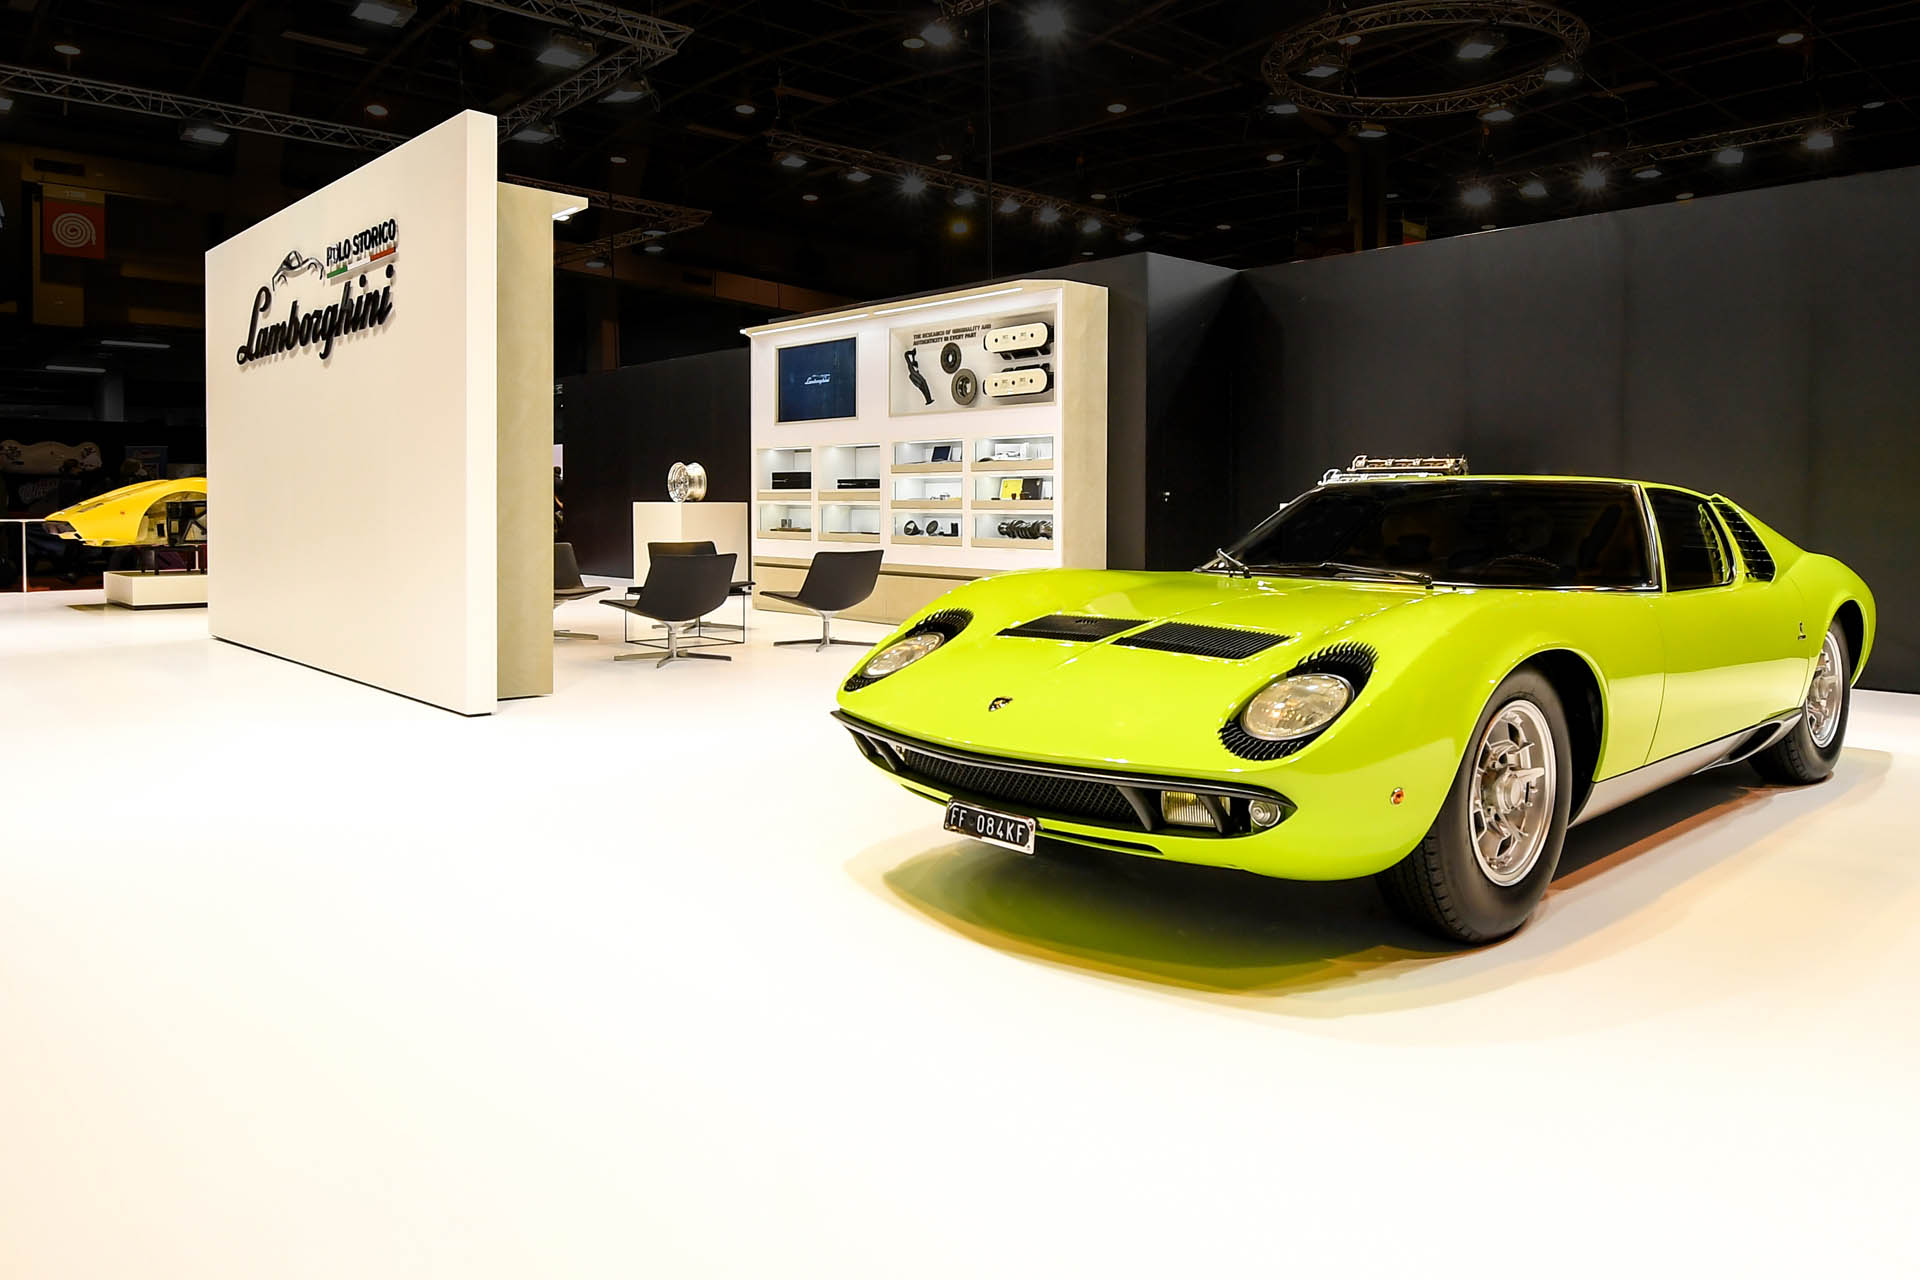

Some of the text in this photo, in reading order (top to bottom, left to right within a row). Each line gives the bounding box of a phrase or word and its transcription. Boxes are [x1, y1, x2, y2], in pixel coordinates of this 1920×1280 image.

[327, 219, 396, 266] POLO STORICO
[236, 264, 394, 365] Lamborghini
[950, 807, 1026, 843] FF 084KF
